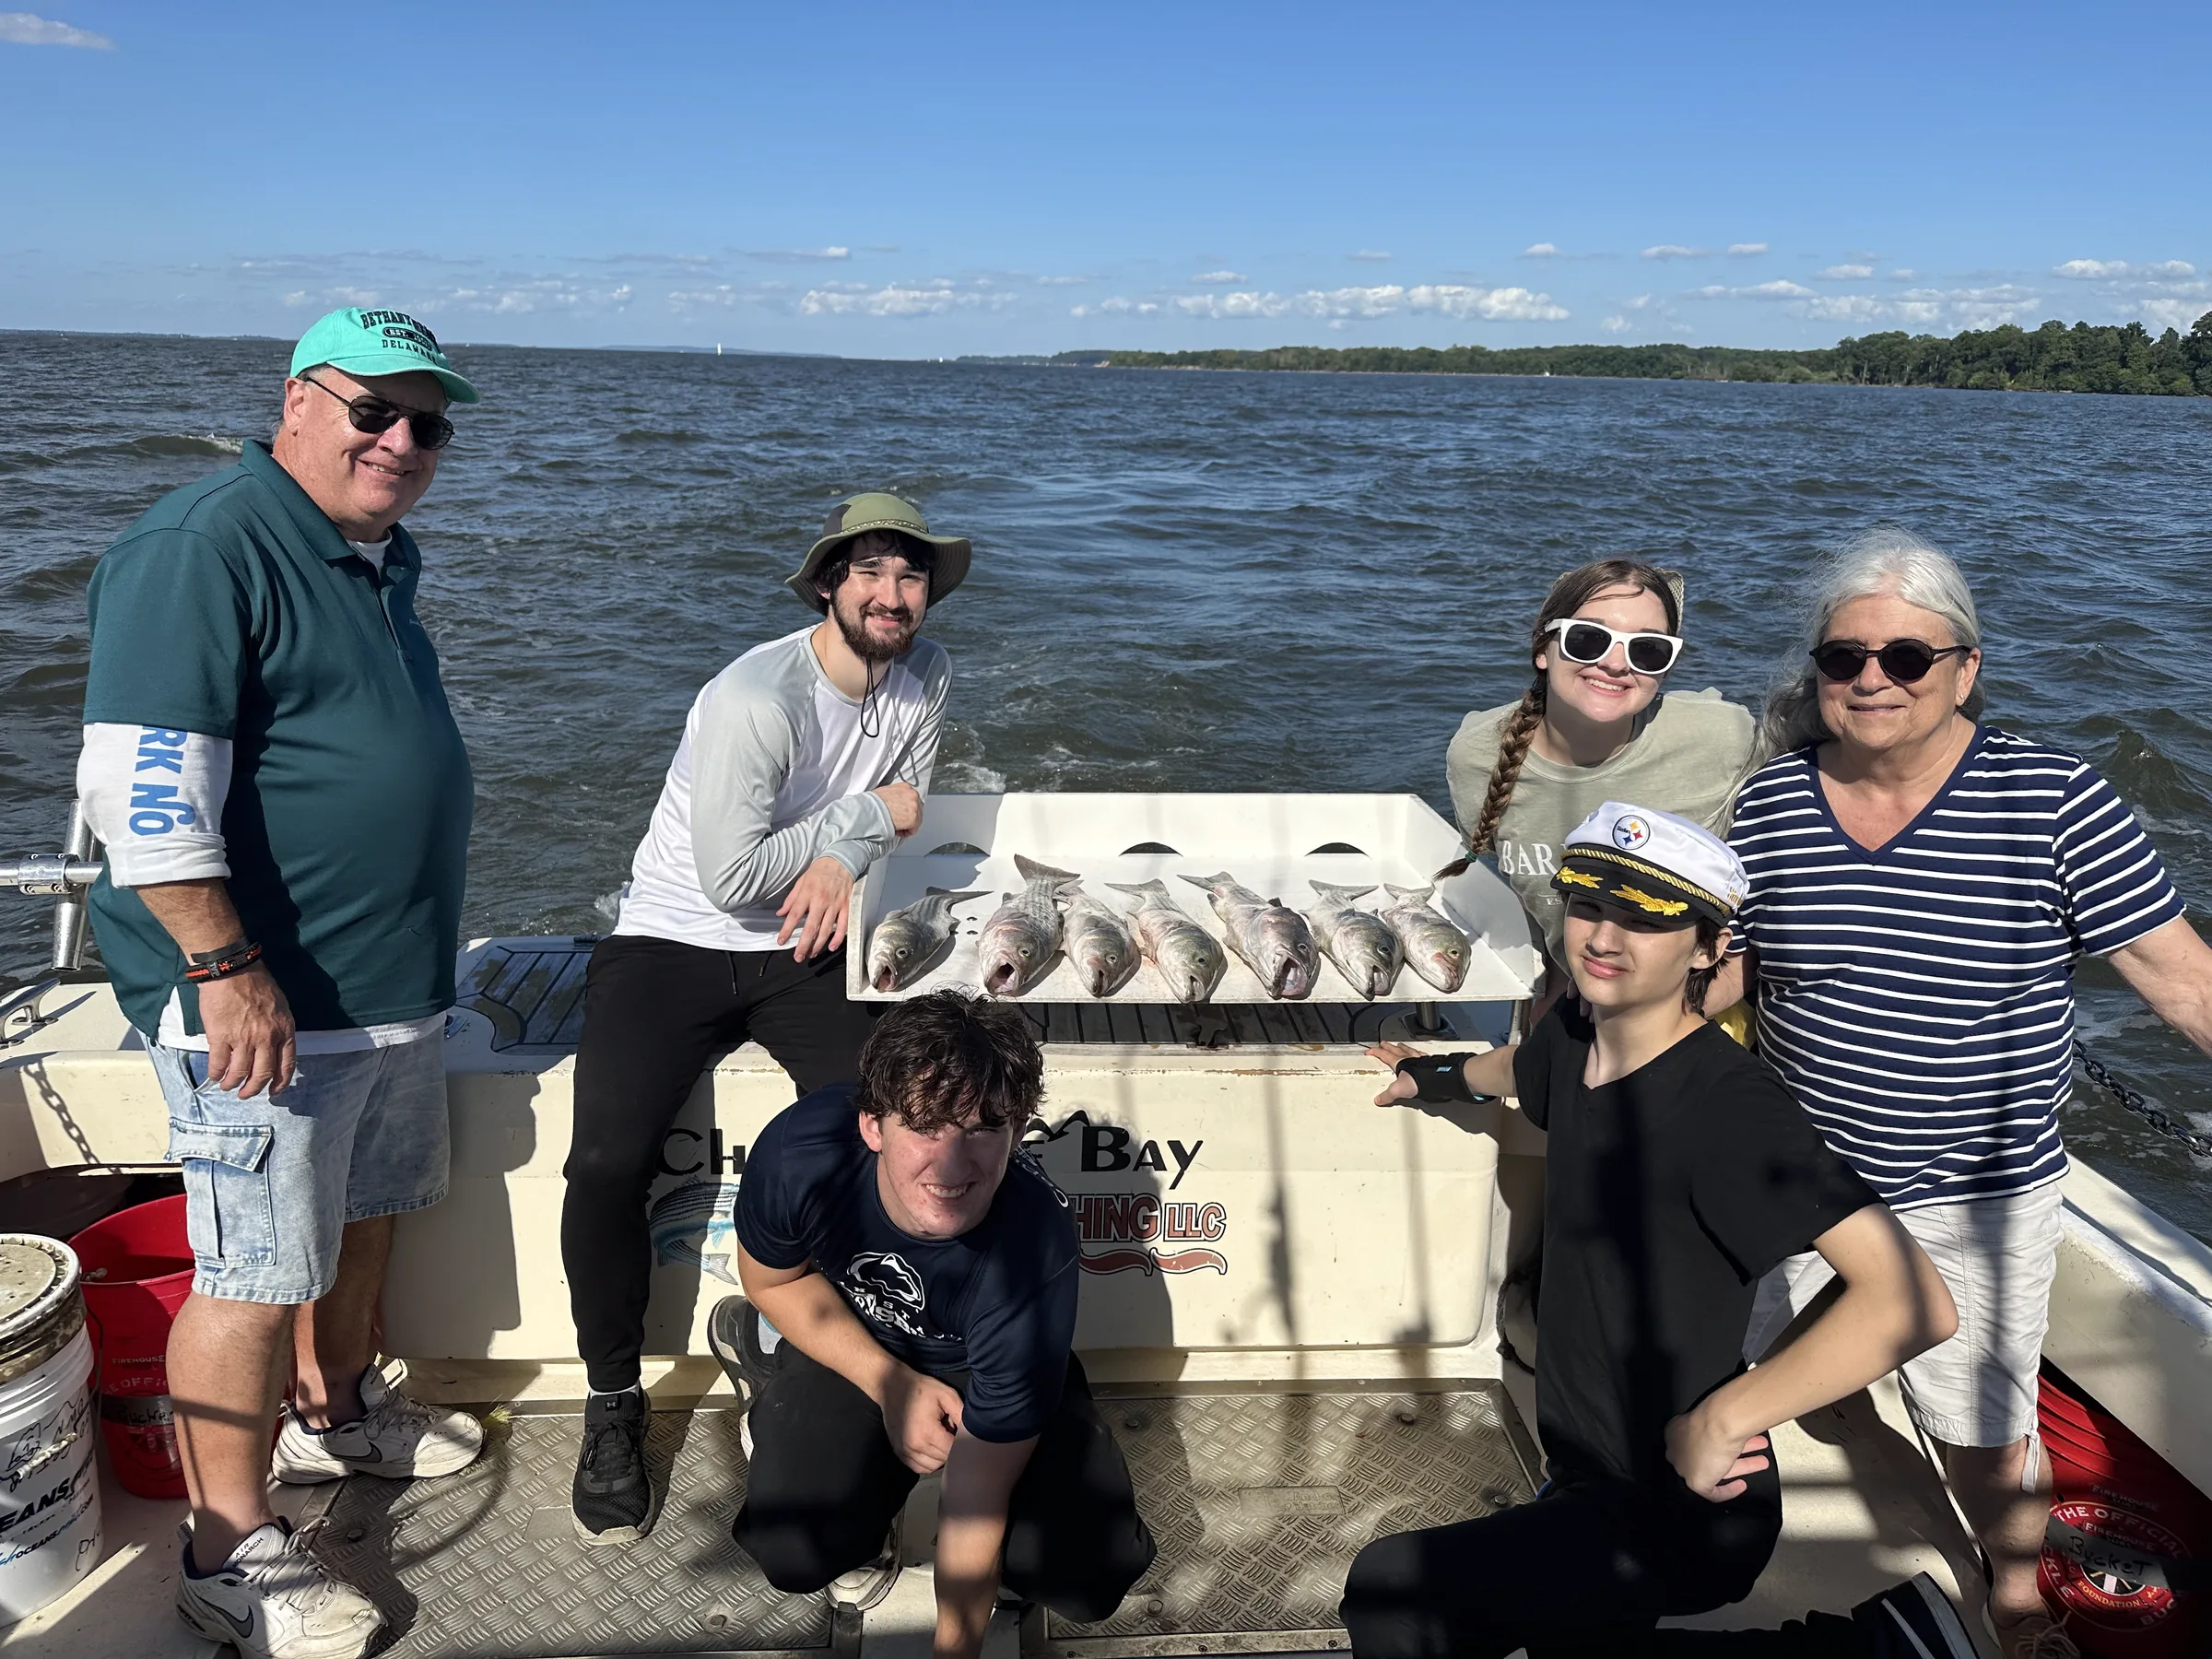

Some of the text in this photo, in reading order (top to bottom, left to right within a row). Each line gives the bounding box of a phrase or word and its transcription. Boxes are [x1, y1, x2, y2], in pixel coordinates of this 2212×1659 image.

[360, 311, 412, 329] BETHANY
[1502, 840, 1559, 876] BAR
[1546, 898, 1563, 906] ES
[1067, 1193, 1227, 1243] HING LLC
[0, 1477, 70, 1533] EANS
[2053, 1506, 2183, 1559] THE OFFICIAL
[232, 1536, 264, 1568] MONARCH
[235, 1543, 250, 1559] AIR
[2043, 1545, 2075, 1599] CKLE
[2077, 1580, 2140, 1607] FOUNDATION
